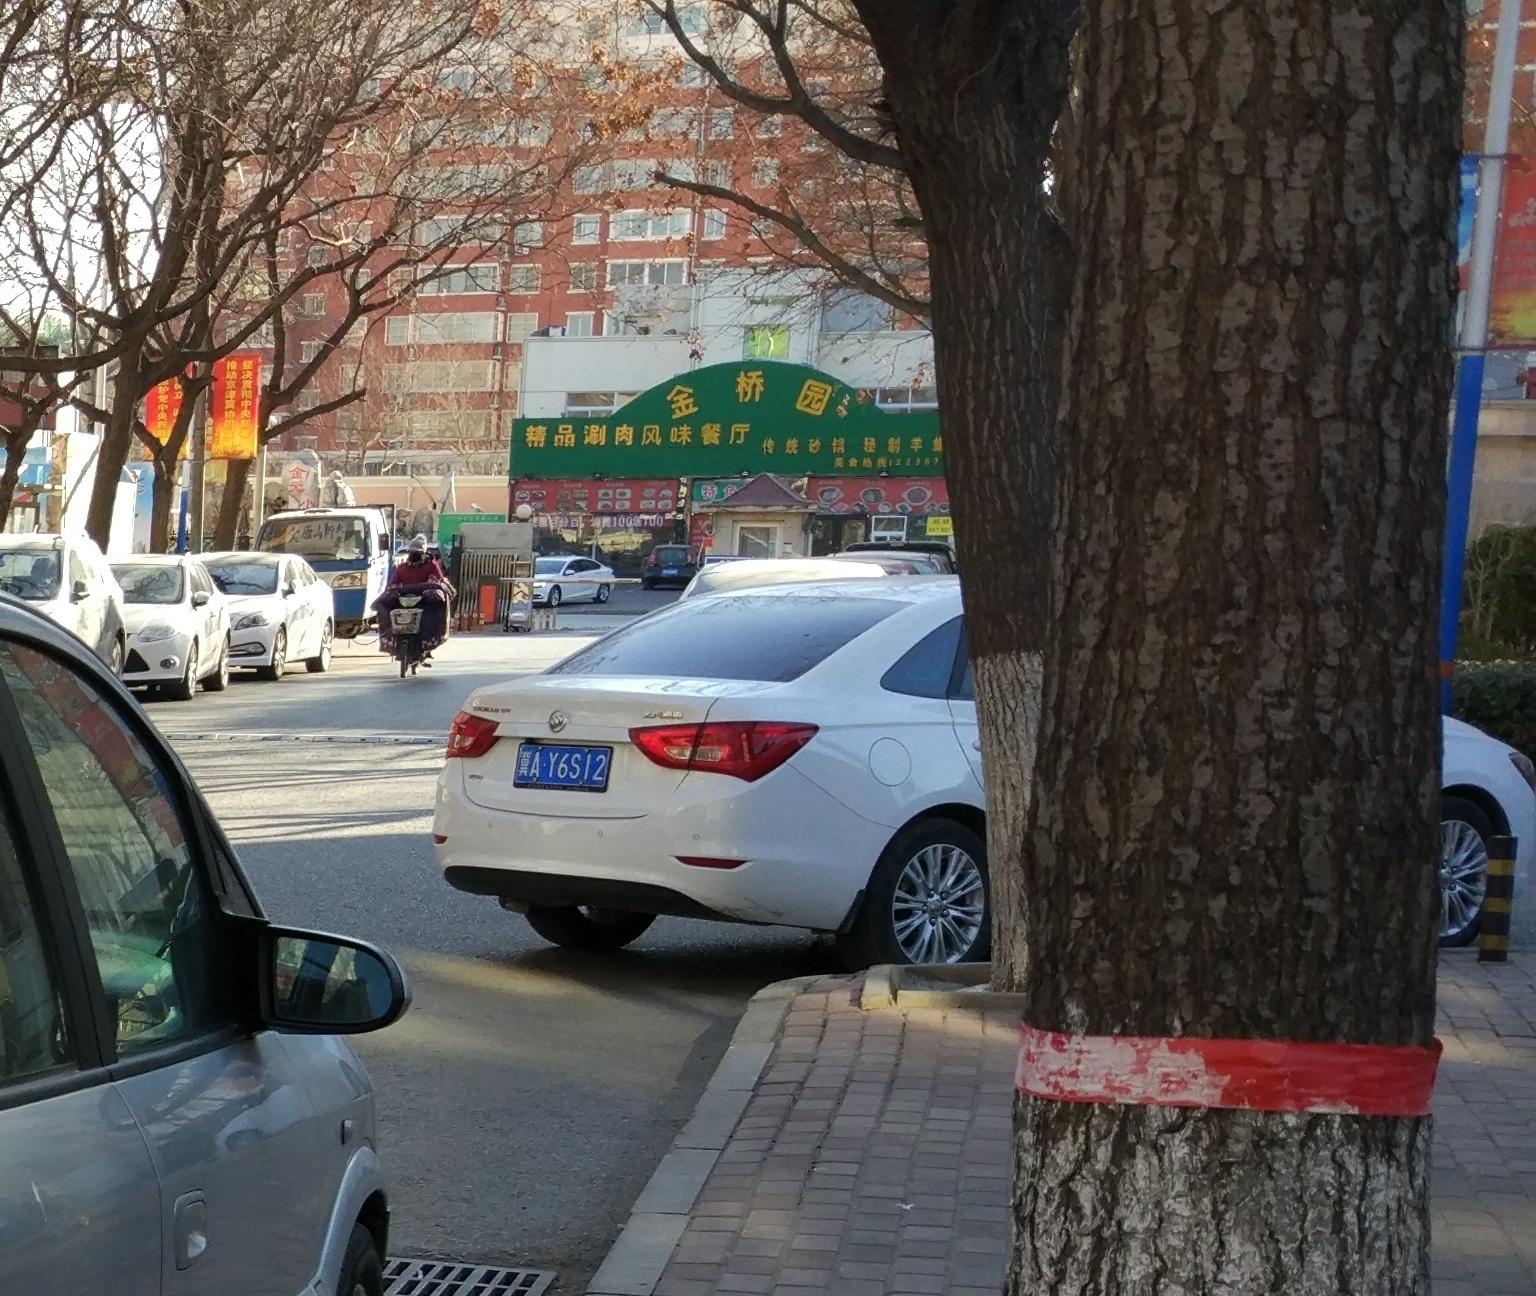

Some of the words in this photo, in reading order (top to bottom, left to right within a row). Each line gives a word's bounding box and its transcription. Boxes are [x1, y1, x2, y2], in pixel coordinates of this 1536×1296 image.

[666, 369, 835, 420] 金桥园
[525, 423, 751, 447] 精品涮肉风味餐厅
